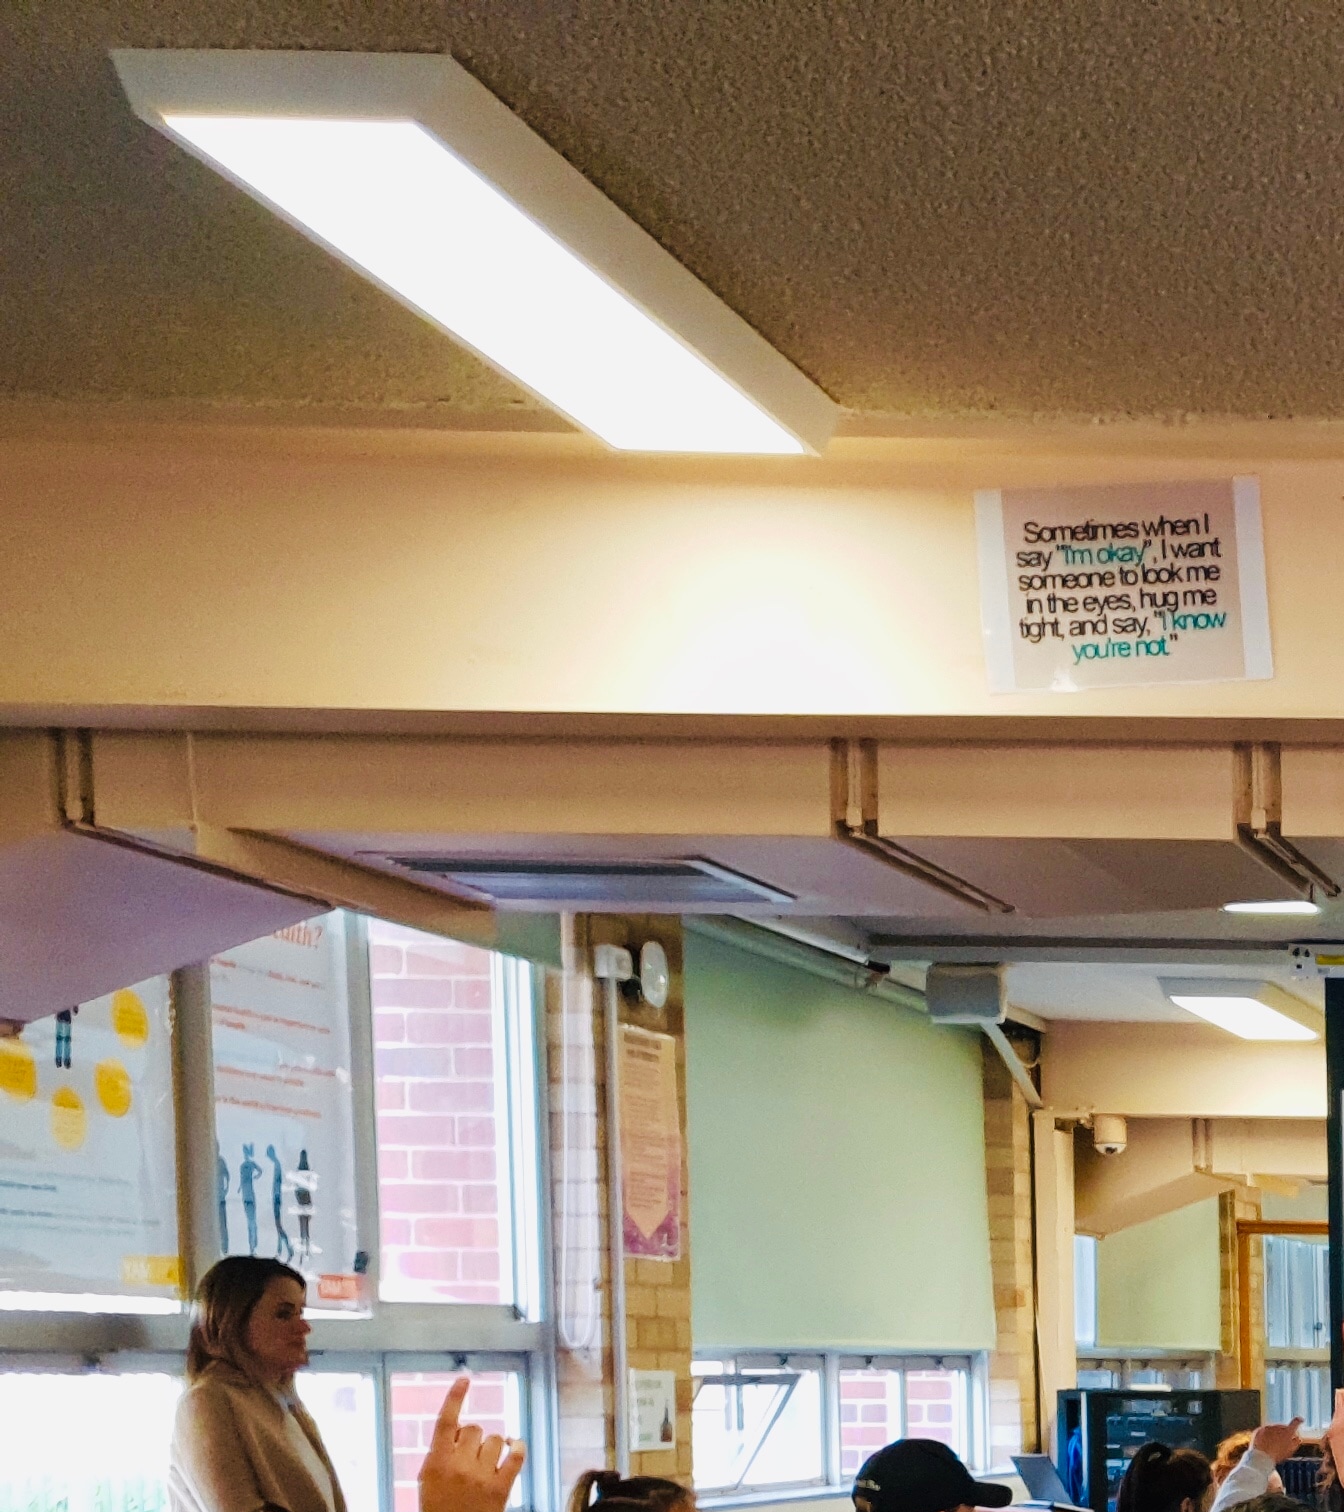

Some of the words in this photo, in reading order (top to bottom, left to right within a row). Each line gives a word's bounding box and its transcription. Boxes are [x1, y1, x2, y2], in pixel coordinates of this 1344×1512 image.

[1023, 518, 1139, 543] Sometimes
[1141, 514, 1200, 537] when
[1203, 512, 1210, 535] I
[1016, 550, 1053, 573] say
[1161, 538, 1167, 560] I
[1169, 536, 1222, 559] want
[1018, 570, 1116, 592] someone
[1119, 565, 1139, 586] to
[1141, 561, 1183, 584] look
[1186, 564, 1221, 583] me
[1025, 591, 1044, 614] in
[1046, 592, 1079, 614] the
[1082, 592, 1136, 617] eyes,
[1139, 587, 1179, 613] hug
[1182, 588, 1218, 606] me
[1018, 615, 1065, 644] tight,
[1068, 613, 1108, 637] and
[1112, 616, 1151, 639] say,
[1171, 611, 1227, 630] know
[1071, 637, 1131, 666] you're
